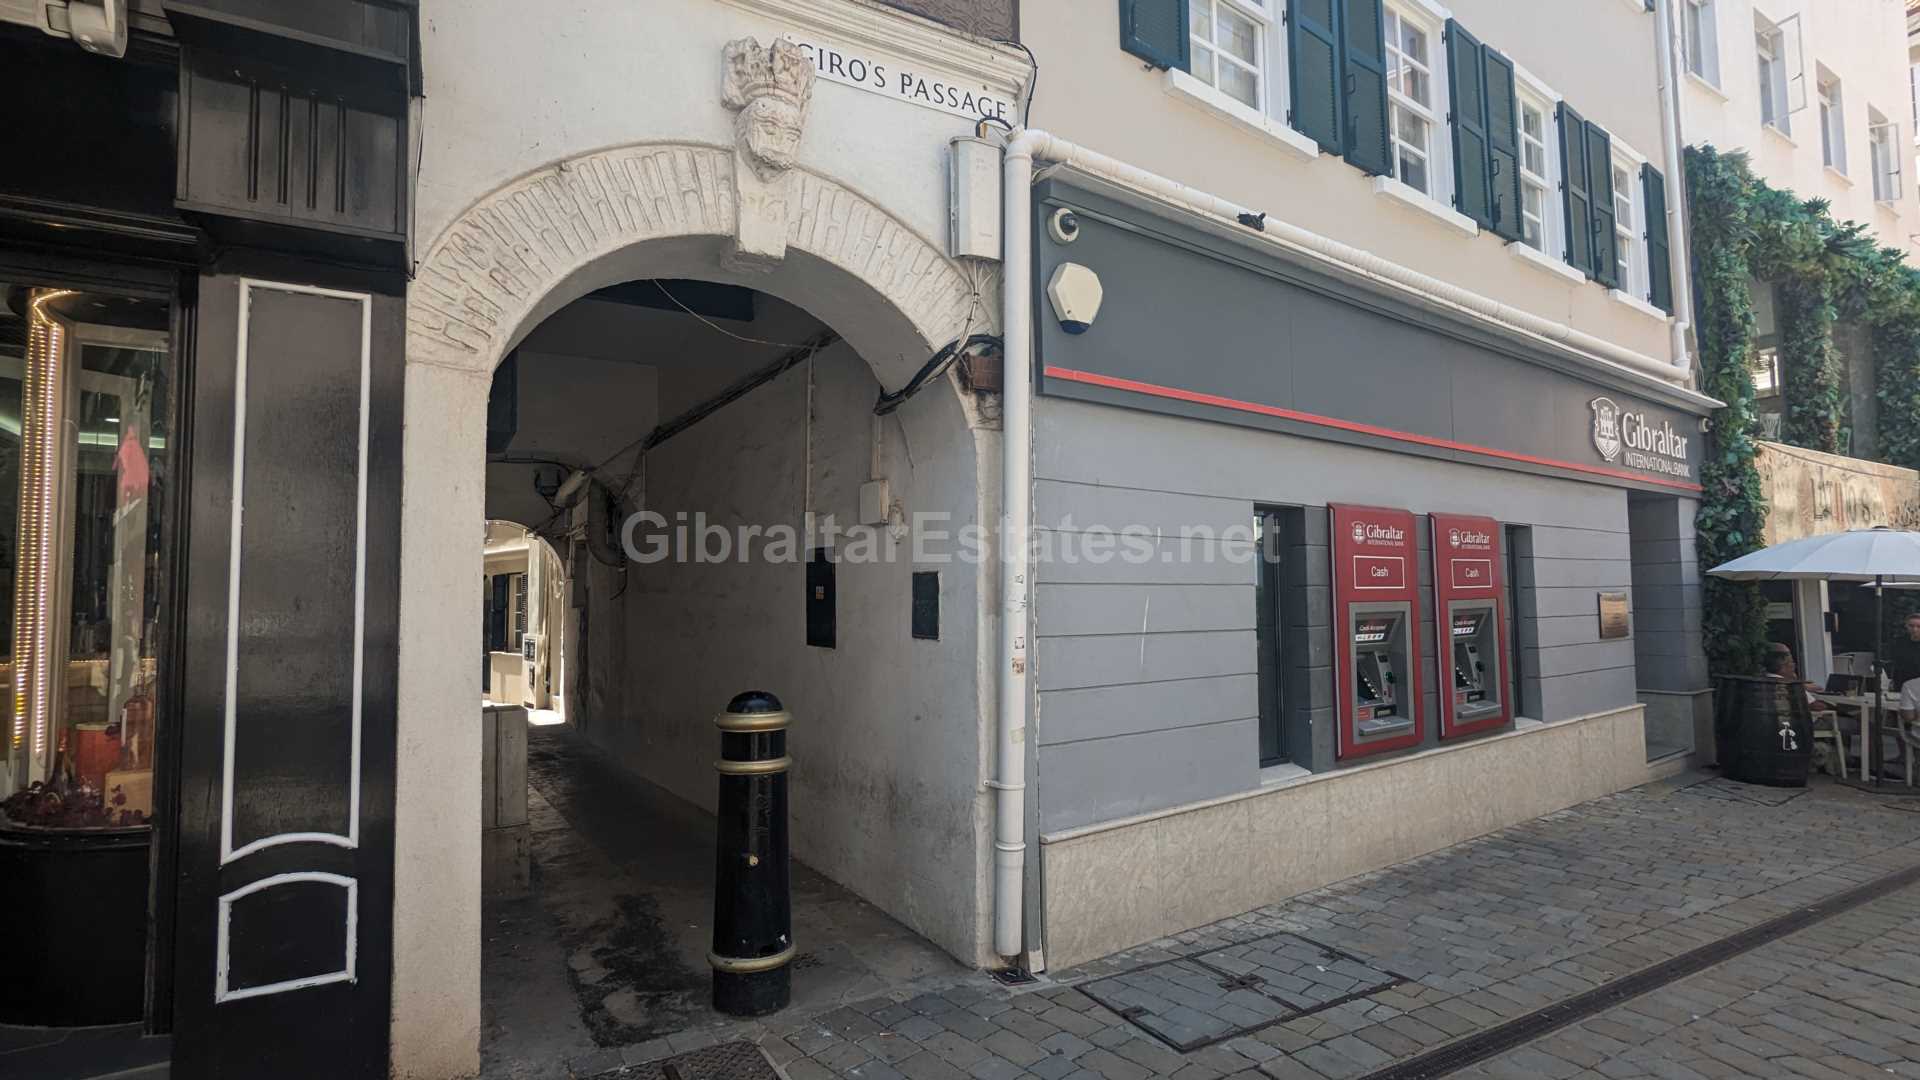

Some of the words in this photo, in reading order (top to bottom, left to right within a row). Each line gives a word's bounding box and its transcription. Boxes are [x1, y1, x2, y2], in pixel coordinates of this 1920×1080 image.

[900, 72, 1006, 118] PASSAGE
[1622, 412, 1688, 460] Gibraltar
[1624, 451, 1674, 475] INTERNATIONAL
[1366, 524, 1404, 540] Gibraltar
[1460, 531, 1490, 544] Gibraltar
[1371, 566, 1389, 577] Cash
[1465, 568, 1480, 578] Cash
